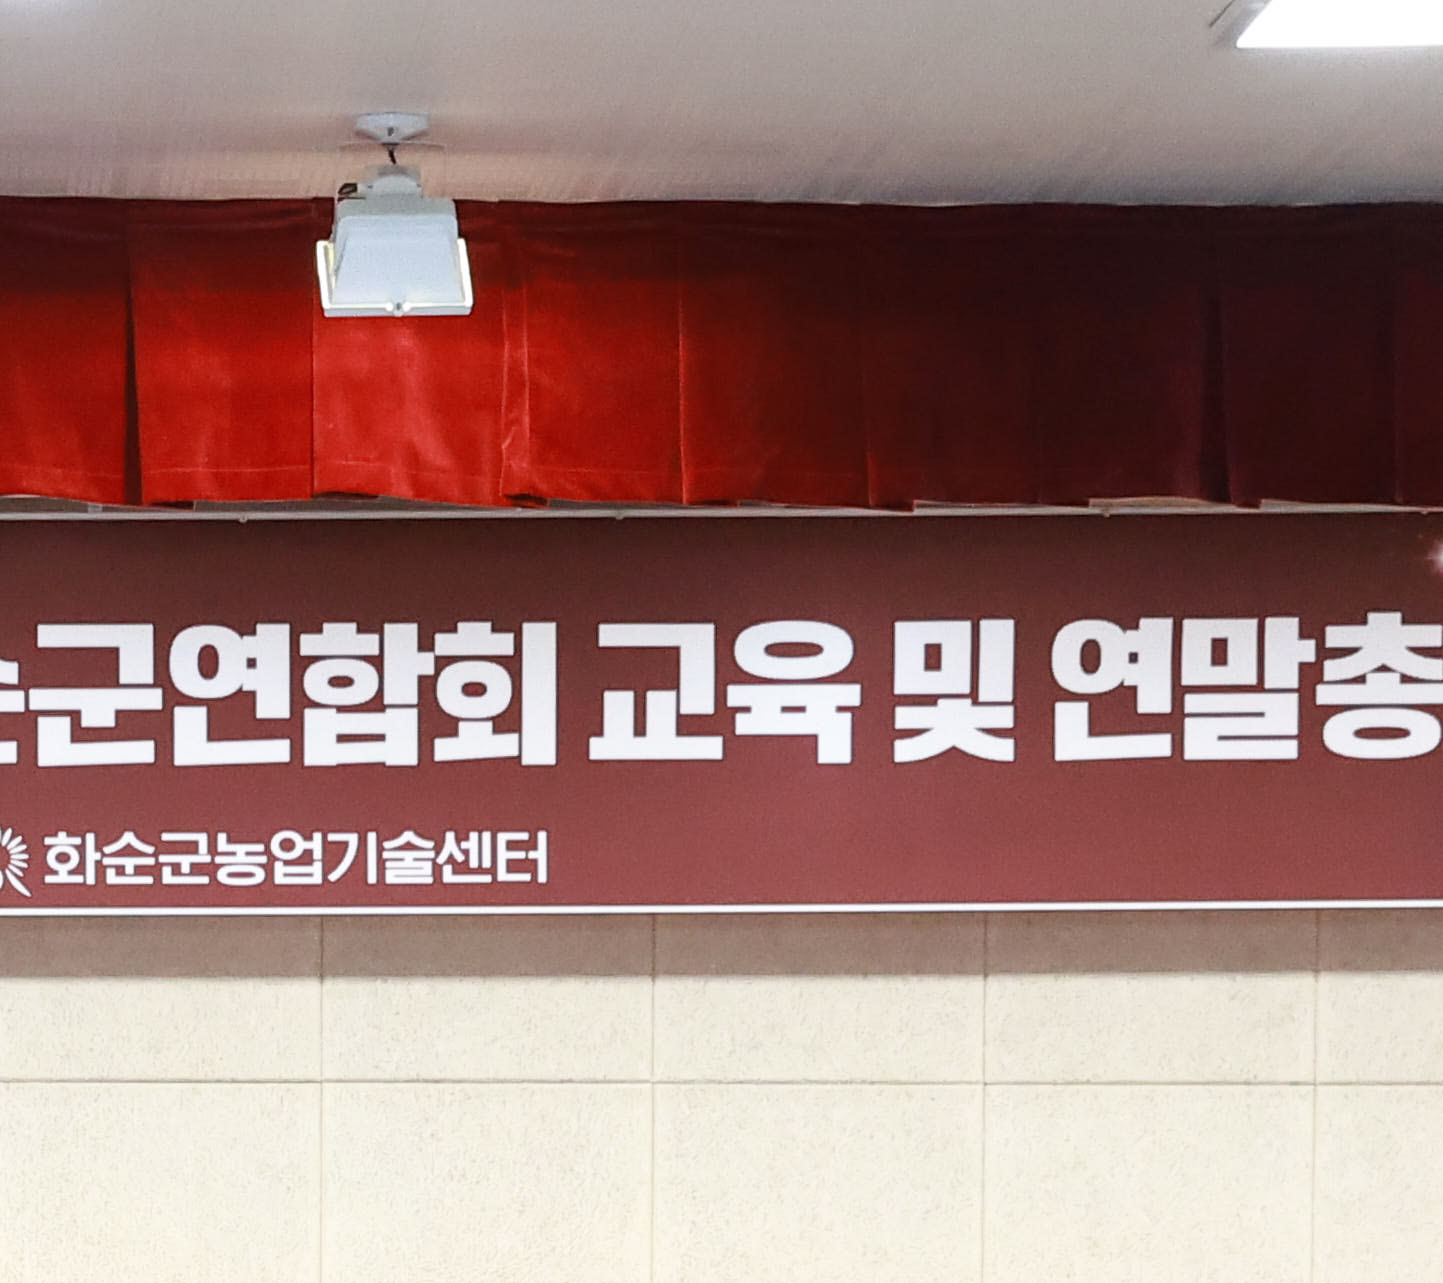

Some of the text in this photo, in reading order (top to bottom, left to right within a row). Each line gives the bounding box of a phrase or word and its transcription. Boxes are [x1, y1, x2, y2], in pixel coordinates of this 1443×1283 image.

[590, 621, 861, 763] 교육
[894, 620, 1014, 762] 및
[44, 831, 547, 885] 화순군농업기술센터
